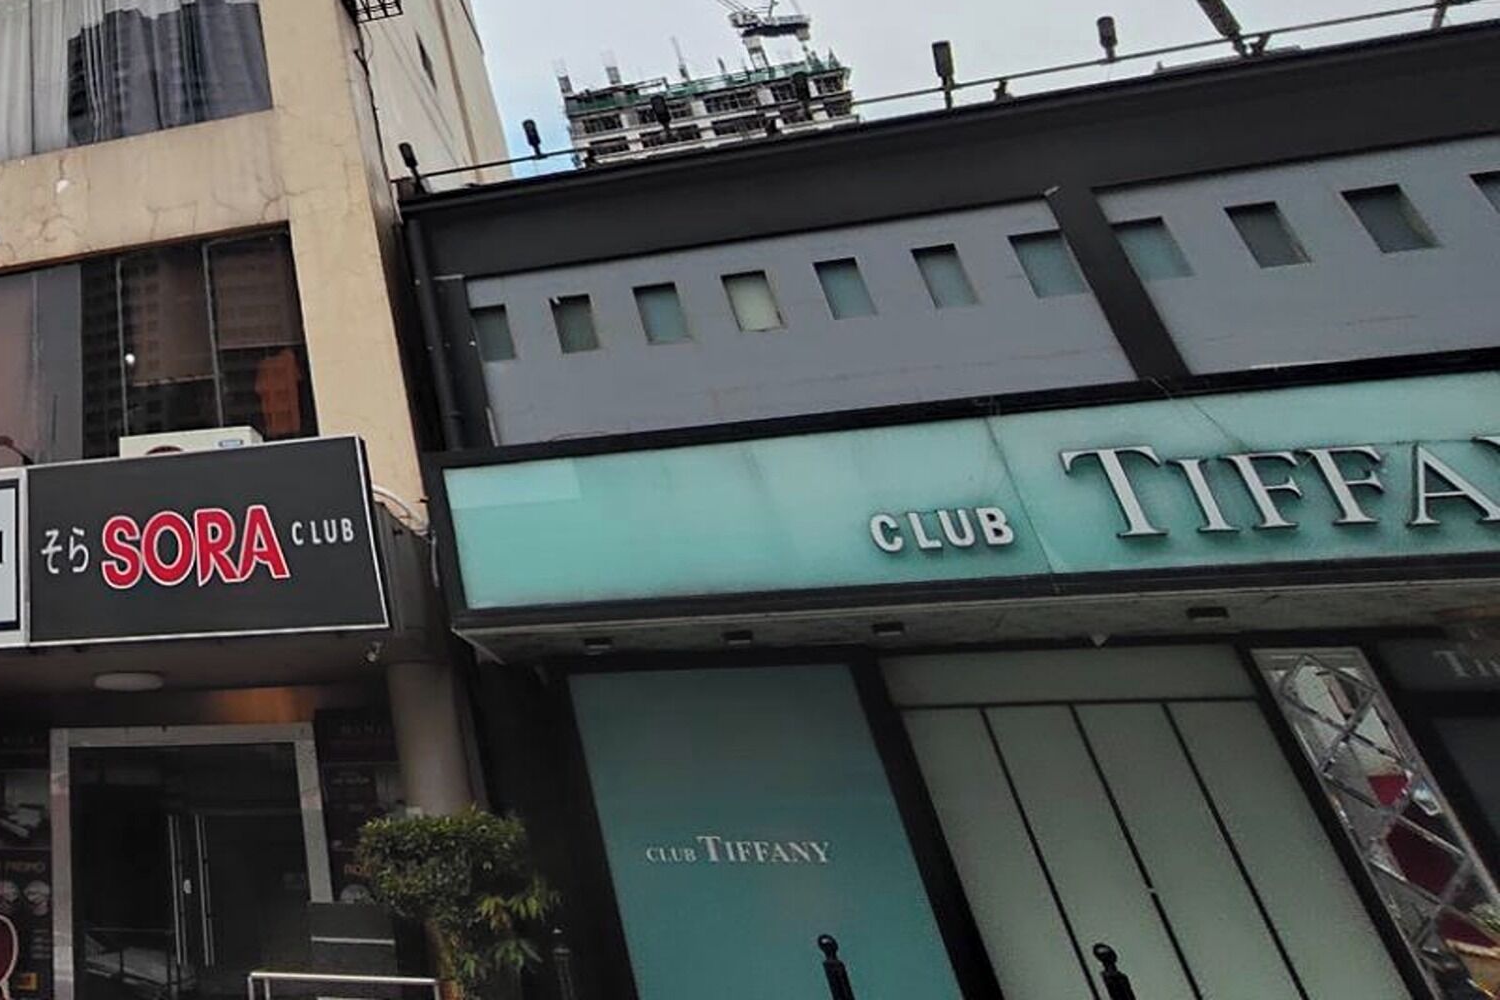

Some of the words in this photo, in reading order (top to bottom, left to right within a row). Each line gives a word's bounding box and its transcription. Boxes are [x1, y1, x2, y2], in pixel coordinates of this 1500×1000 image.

[869, 506, 1015, 553] CLUB
[1059, 436, 1500, 538] TIFFA
[41, 518, 89, 574] そら
[102, 504, 291, 589] SORA
[291, 518, 354, 545] CLUB
[646, 847, 697, 863] CLUB
[696, 835, 829, 863] TIFFANY
